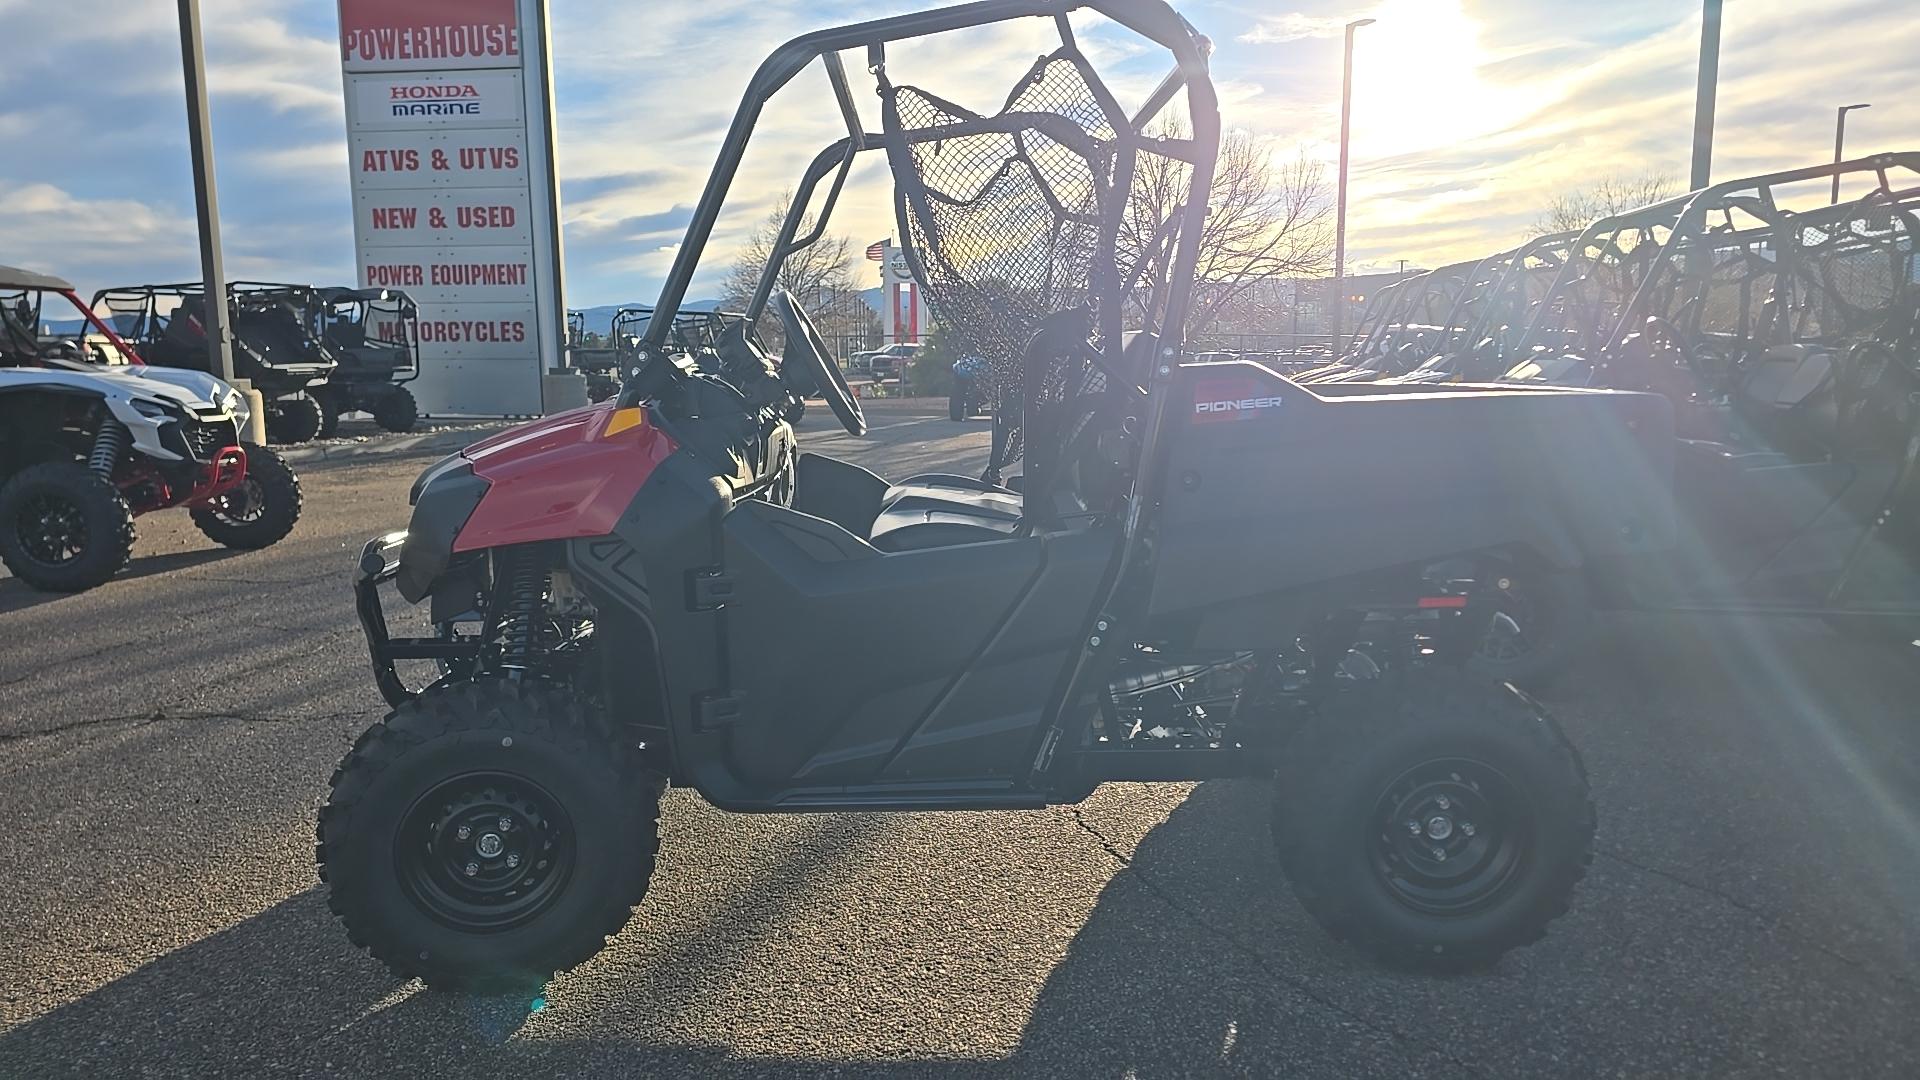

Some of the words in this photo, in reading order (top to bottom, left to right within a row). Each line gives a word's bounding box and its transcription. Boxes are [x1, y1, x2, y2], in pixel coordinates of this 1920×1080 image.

[344, 25, 518, 61] POWERHOUSE
[390, 85, 480, 99] HONDA
[363, 149, 419, 171] ATVS
[432, 149, 450, 170] &
[460, 147, 518, 169] UTVS
[372, 207, 416, 229] NEW
[429, 207, 447, 228] &
[457, 206, 515, 228] USED
[367, 265, 423, 286] POWER
[431, 264, 526, 286] EQUIPMENT
[1195, 396, 1282, 413] PIONEER
